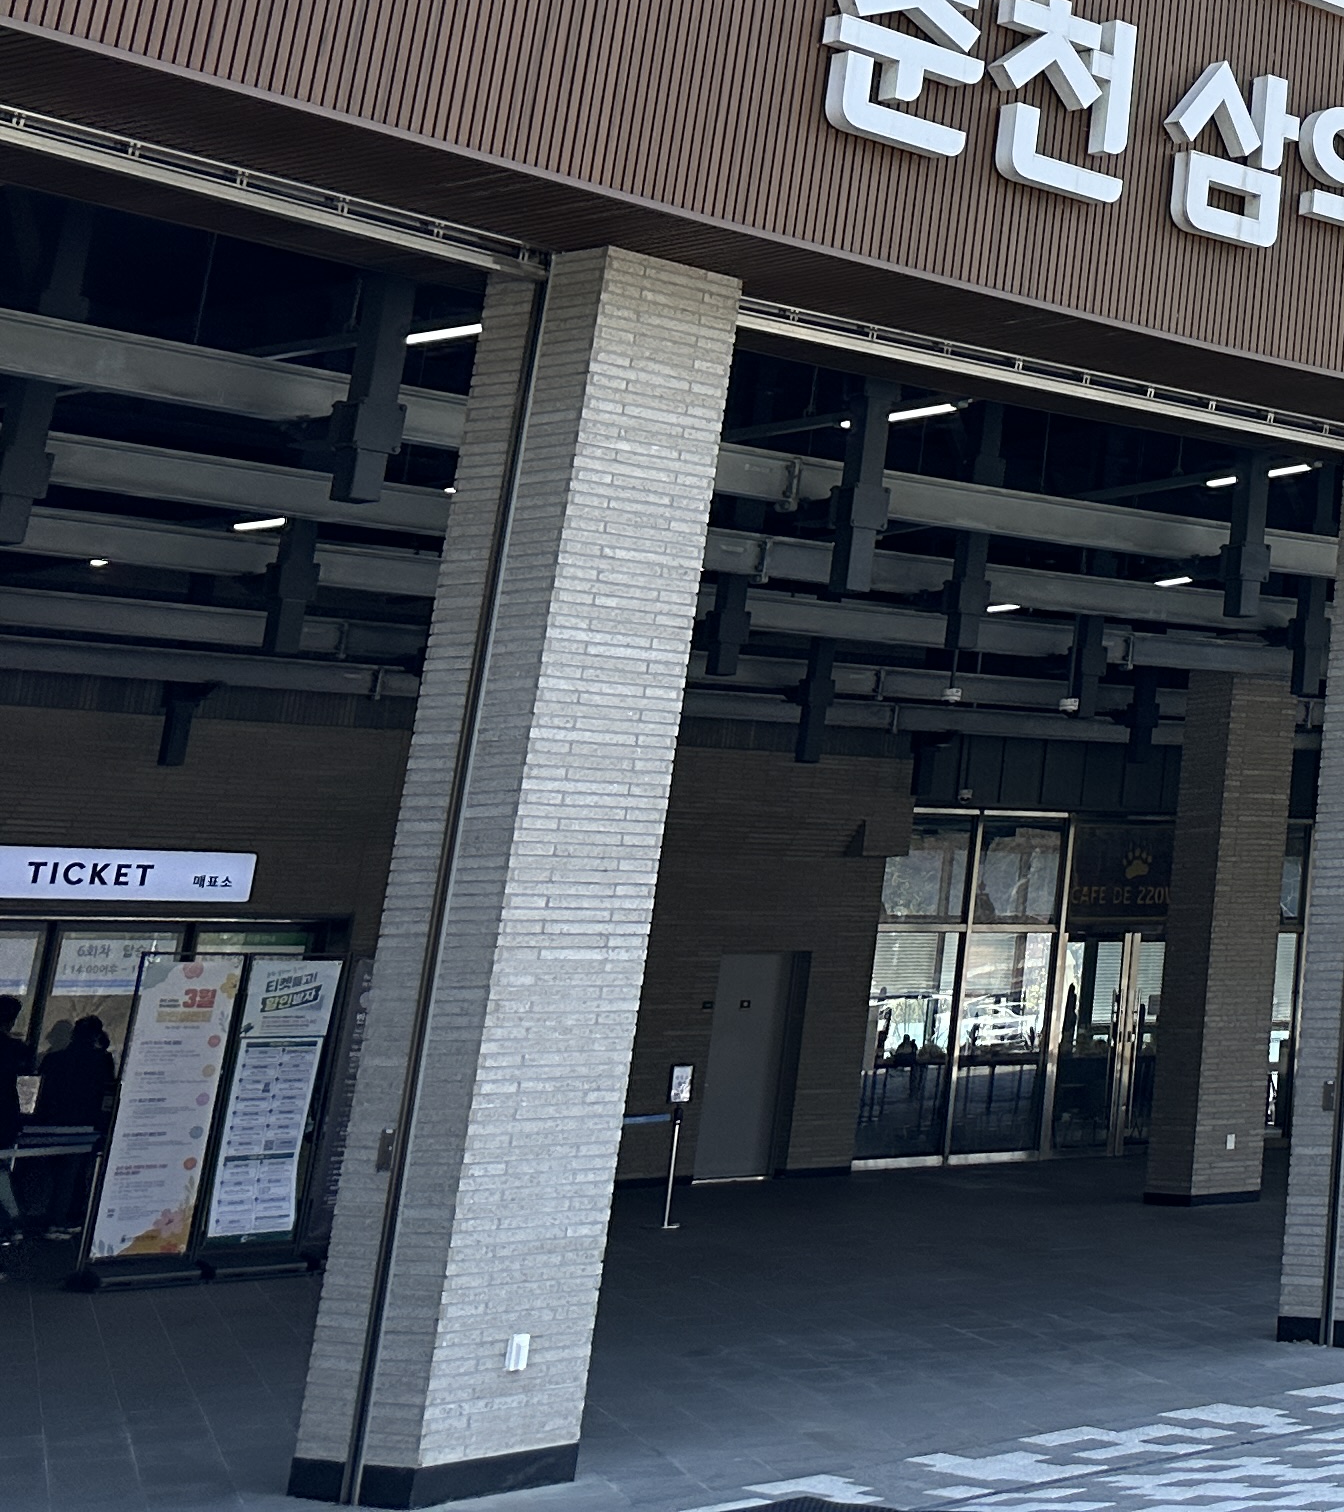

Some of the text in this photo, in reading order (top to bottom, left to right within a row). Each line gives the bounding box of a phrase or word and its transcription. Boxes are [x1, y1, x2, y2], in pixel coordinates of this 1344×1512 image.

[28, 861, 233, 888] TICKET 매표소
[1071, 886, 1106, 904] CAFE
[1113, 887, 1131, 904] DE
